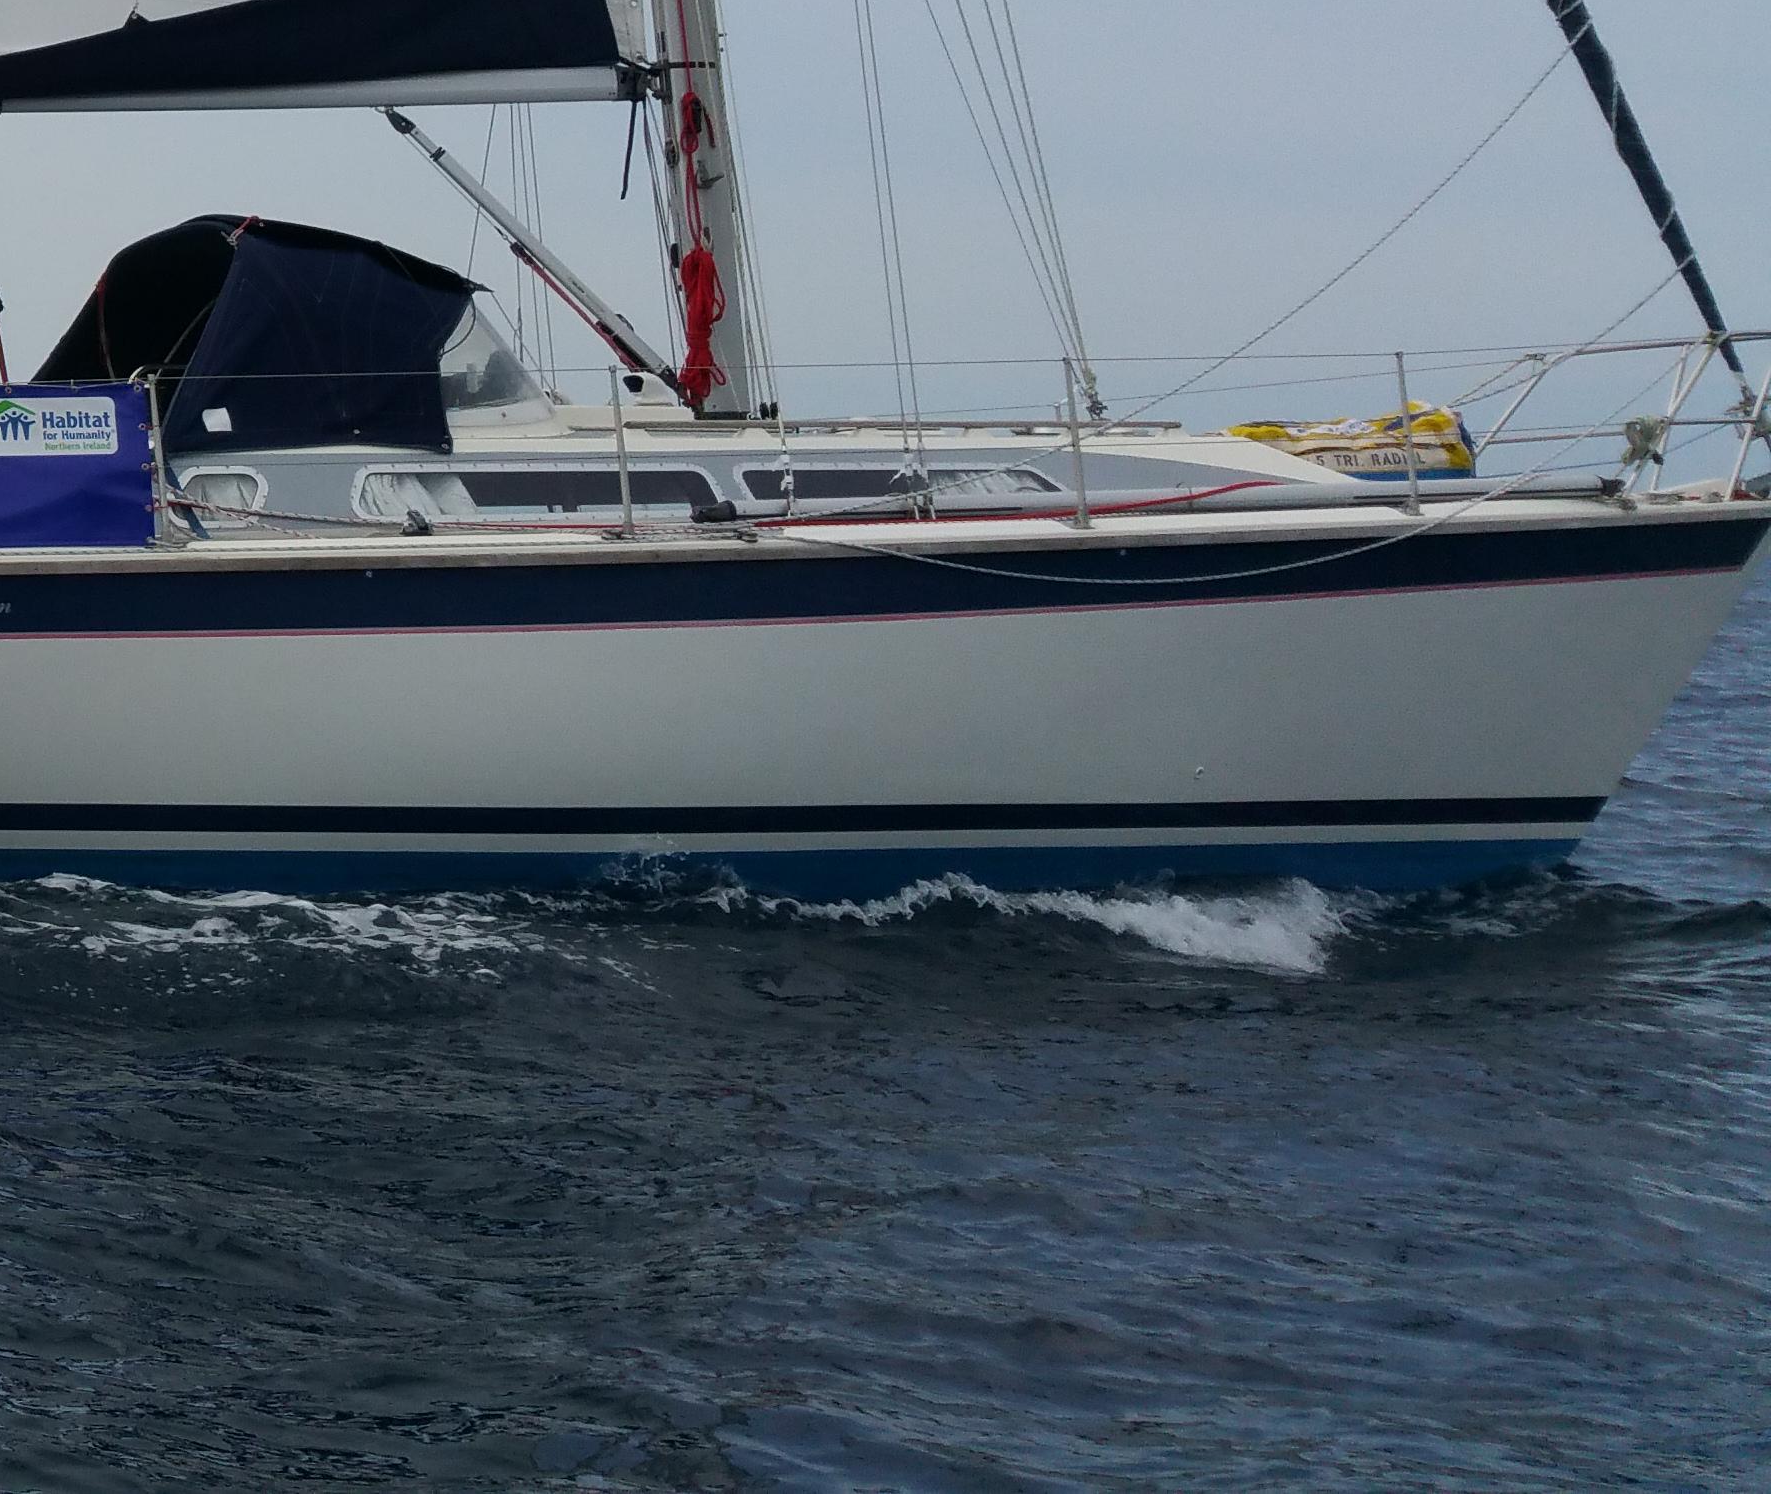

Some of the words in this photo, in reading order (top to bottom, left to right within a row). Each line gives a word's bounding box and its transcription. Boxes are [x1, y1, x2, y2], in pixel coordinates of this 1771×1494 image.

[41, 410, 112, 429] Habitat
[42, 430, 58, 440] for
[61, 429, 111, 442] Humanity
[45, 442, 81, 451] Northern
[83, 441, 112, 450] Ireland
[1371, 453, 1426, 467] RADIL
